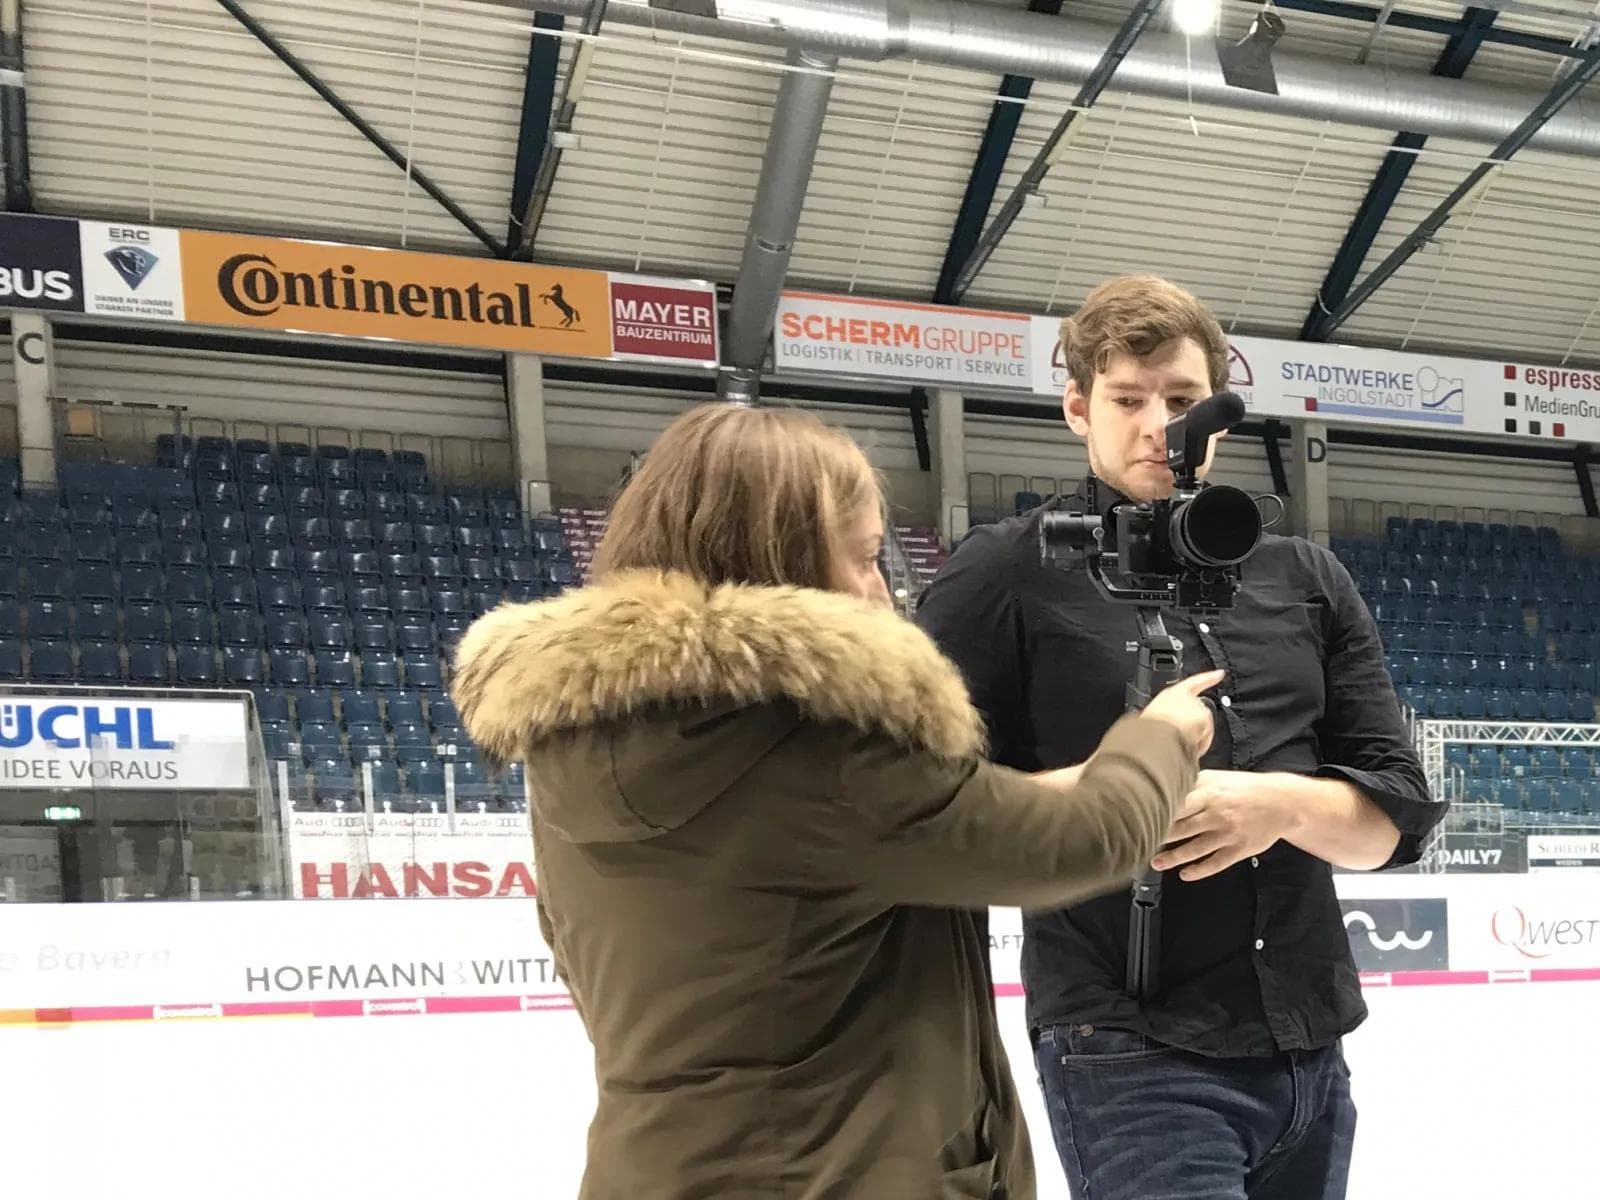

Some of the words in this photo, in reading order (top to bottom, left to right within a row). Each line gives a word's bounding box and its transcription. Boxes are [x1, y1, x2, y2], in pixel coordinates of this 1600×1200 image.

[108, 227, 150, 241] ERC
[217, 252, 535, 328] Continental
[615, 298, 711, 328] MAYER
[17, 332, 45, 365] C
[616, 325, 712, 346] BAUZENTRUM
[782, 342, 852, 362] LOGISTIK
[867, 349, 953, 371] TRANSPORT
[964, 360, 1026, 377] SERVICE
[1281, 361, 1414, 392] STADTWERKE
[1318, 385, 1414, 409] INGOLSTADT
[1307, 437, 1326, 463] D
[4, 759, 62, 779] IDEE
[69, 760, 178, 780] VORAUS
[246, 962, 445, 993] HOFMANN
